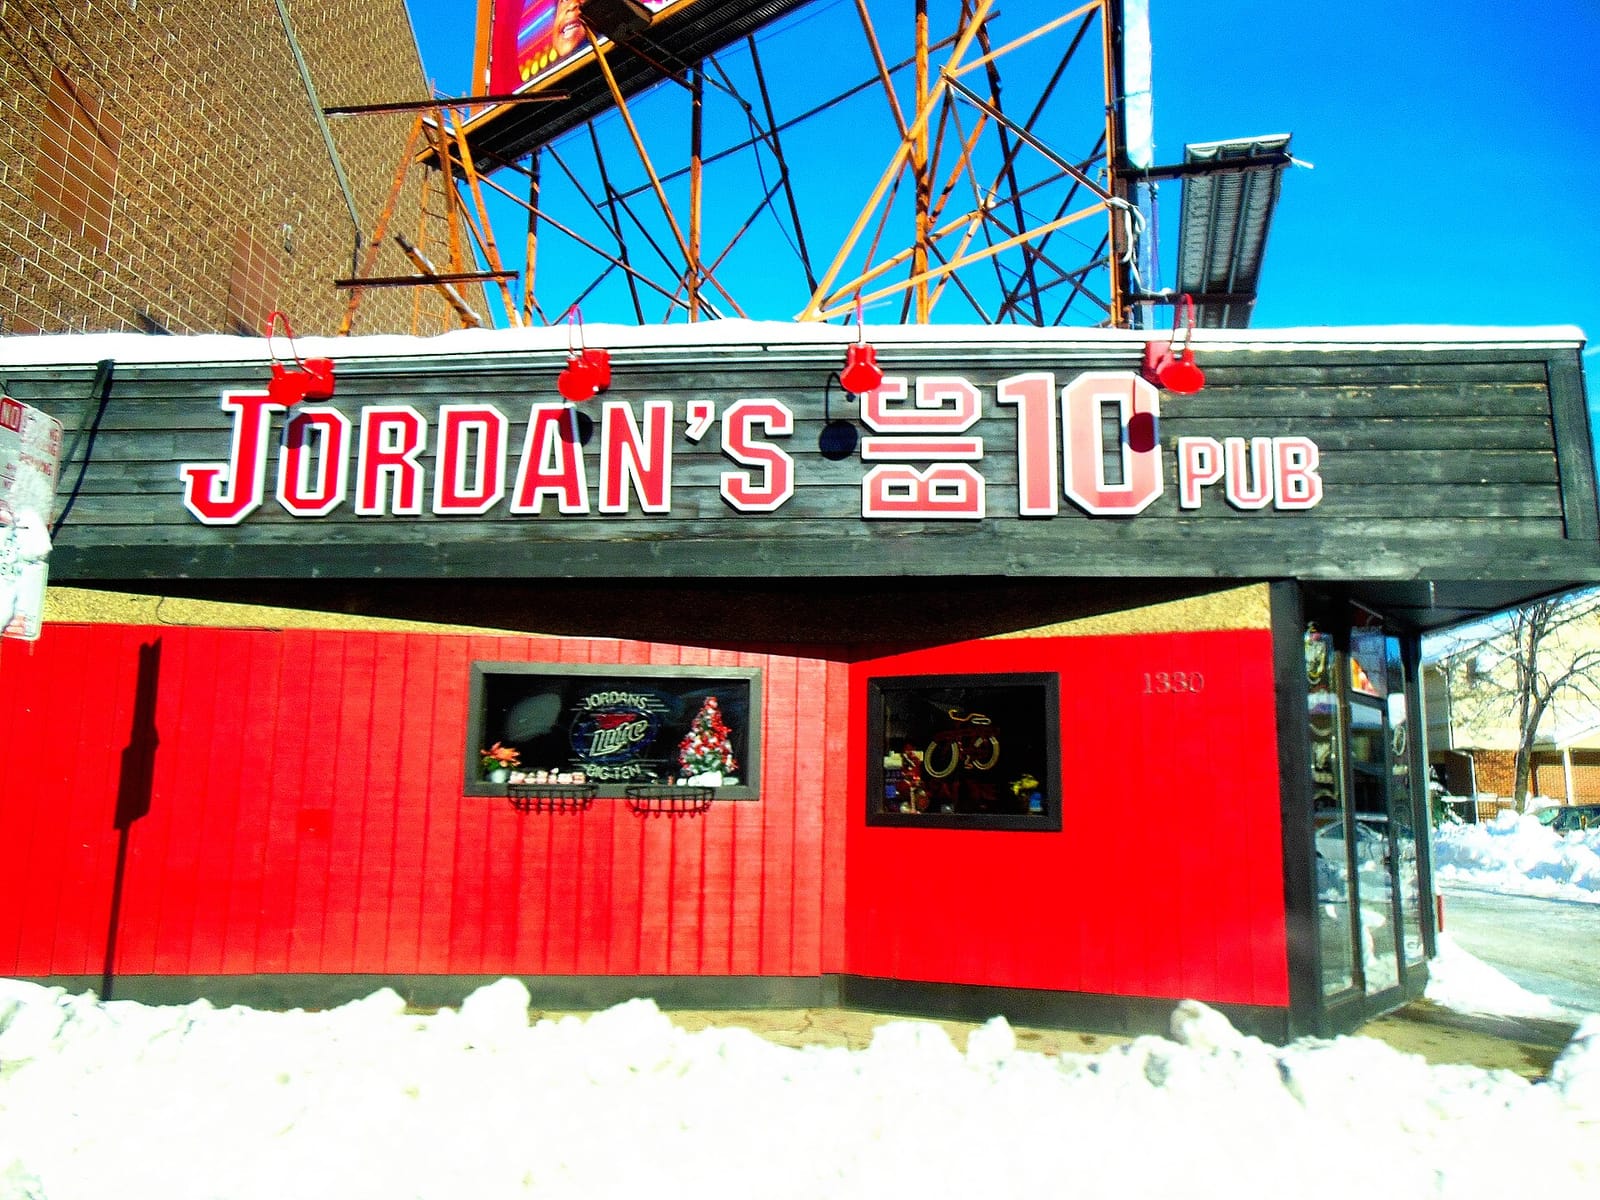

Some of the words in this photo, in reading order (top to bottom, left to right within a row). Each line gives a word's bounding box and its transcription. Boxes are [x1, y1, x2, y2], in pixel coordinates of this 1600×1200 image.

[179, 388, 794, 526] JORDAN'S
[861, 375, 986, 521] BIG
[997, 371, 1165, 517] 10
[1177, 436, 1323, 511] PUB
[1143, 671, 1205, 695] 1330
[583, 690, 649, 711] JORDANS
[612, 763, 641, 780] TEN
